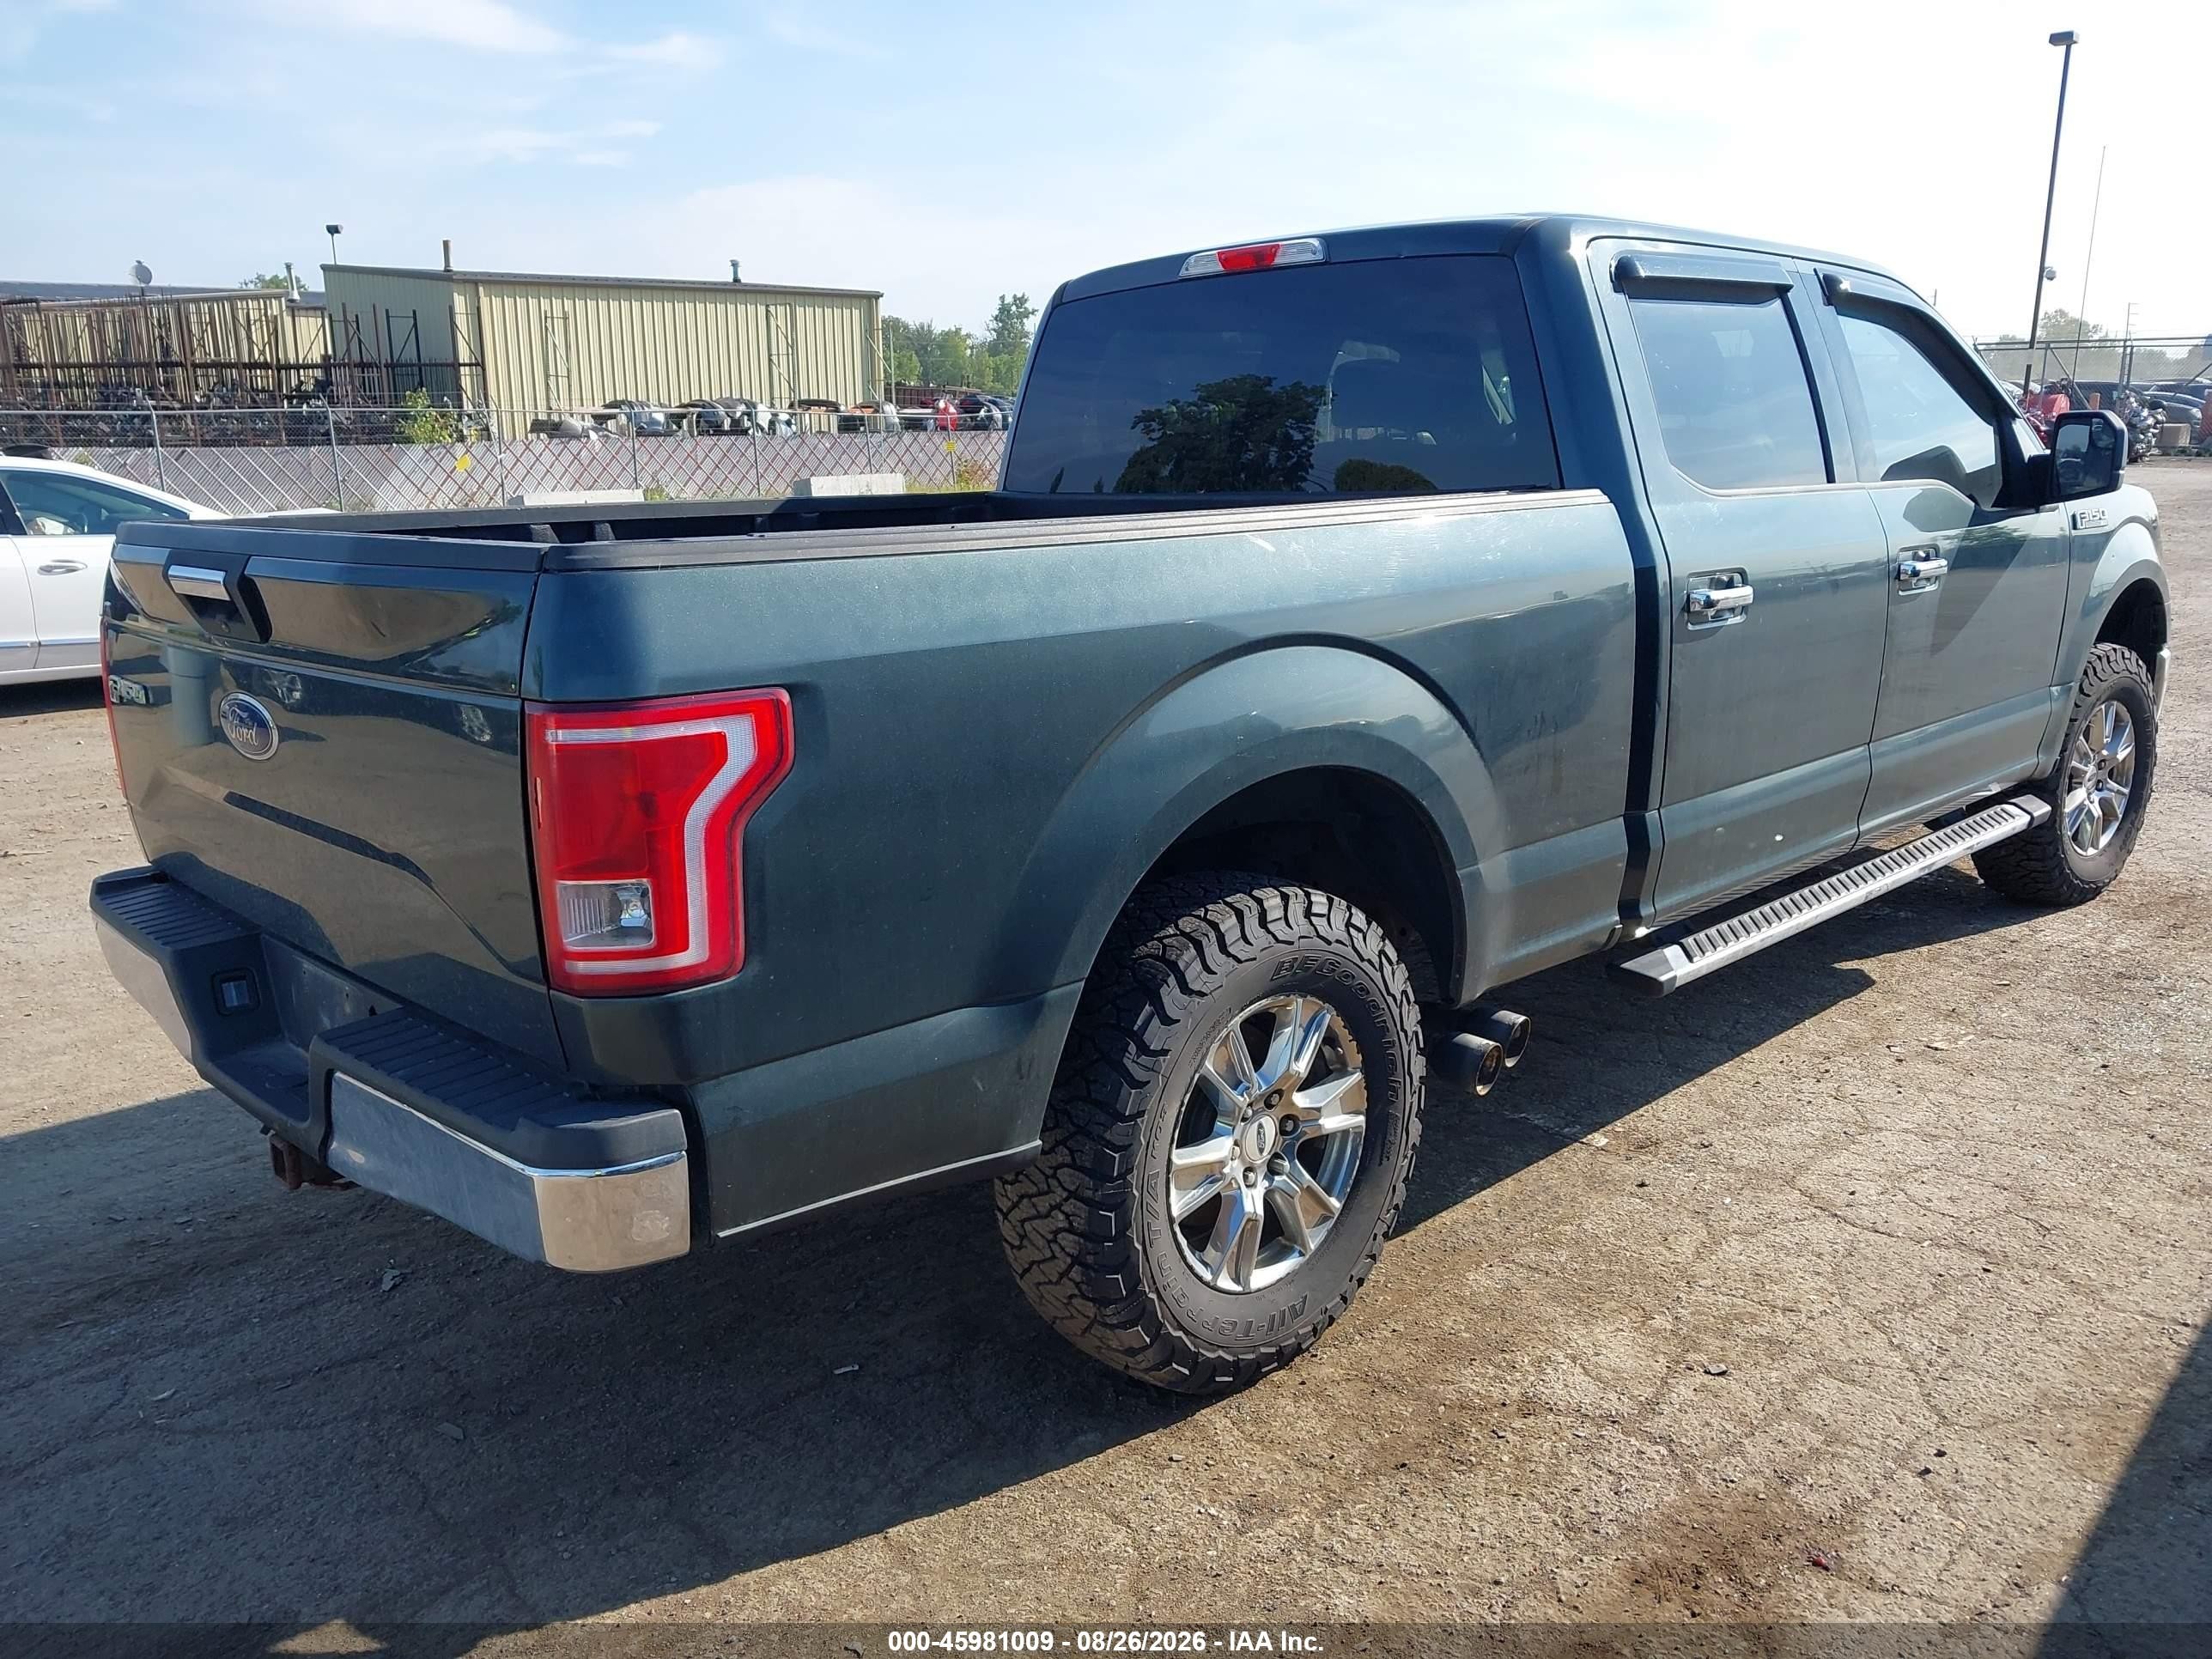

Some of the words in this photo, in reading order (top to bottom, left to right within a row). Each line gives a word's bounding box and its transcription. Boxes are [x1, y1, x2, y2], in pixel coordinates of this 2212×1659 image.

[1270, 953, 1402, 1102] BFGoodrich
[1146, 1168, 1161, 1249] T/A
[1157, 1252, 1310, 1341] All-Terrain
